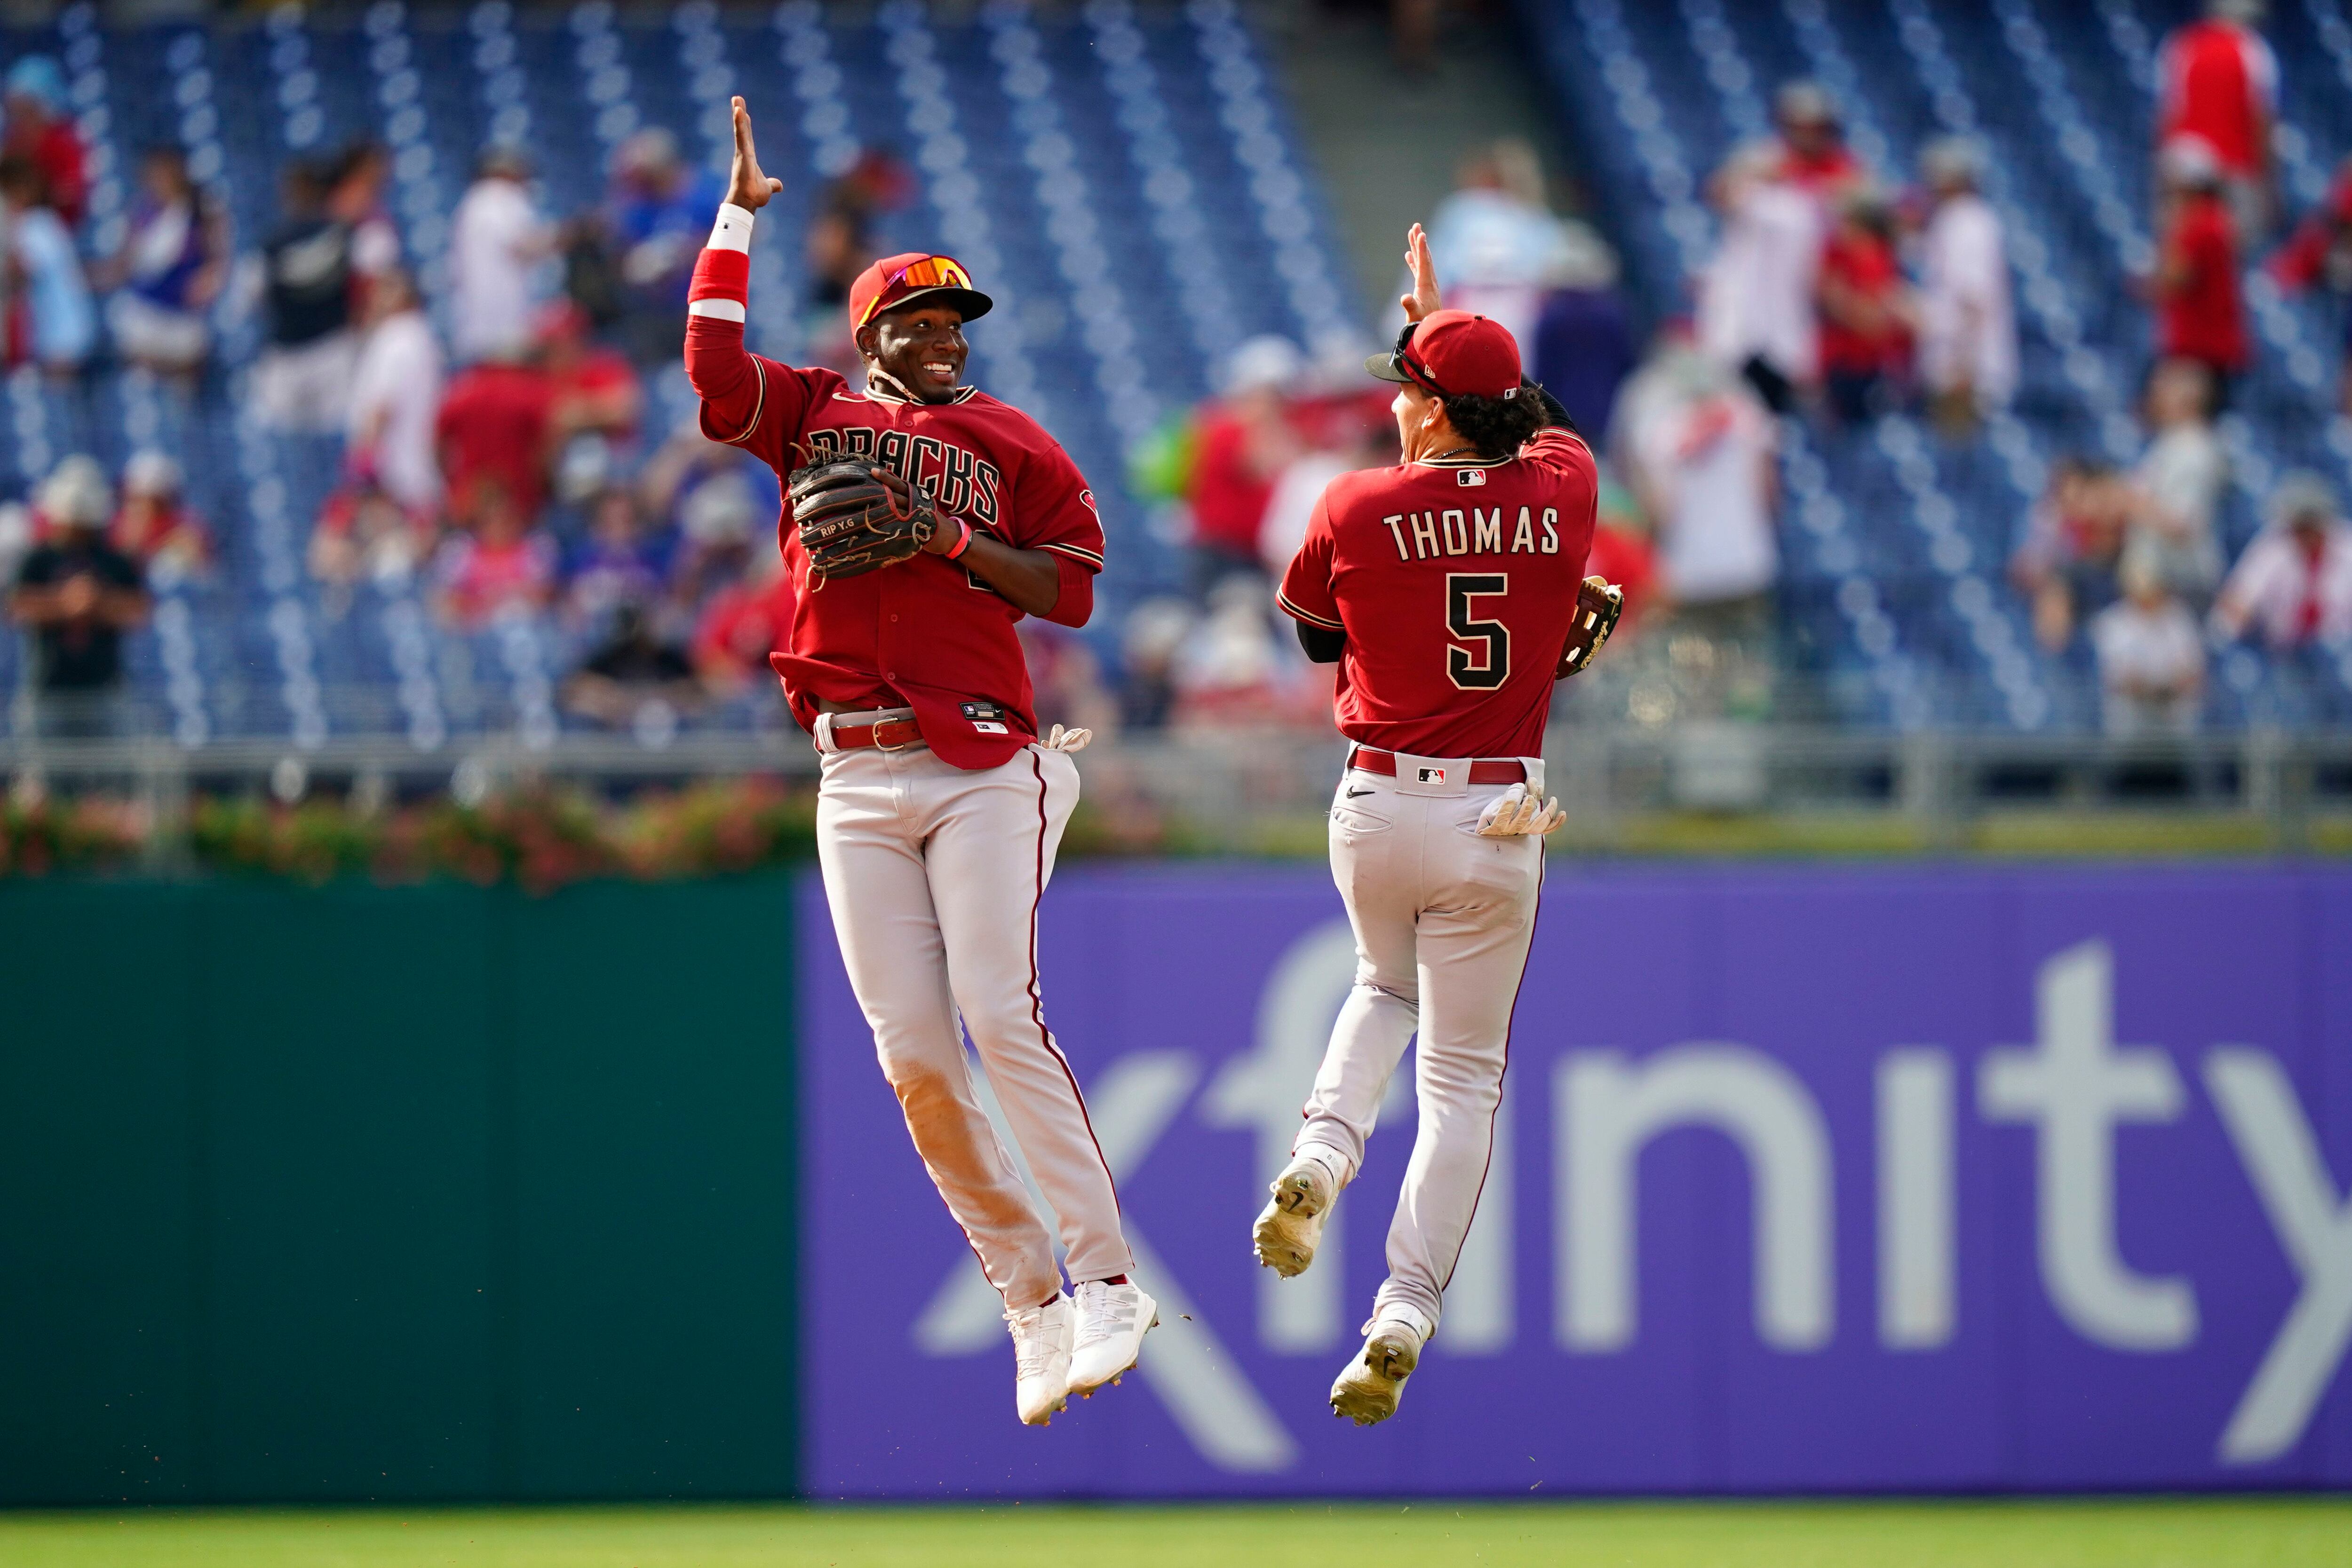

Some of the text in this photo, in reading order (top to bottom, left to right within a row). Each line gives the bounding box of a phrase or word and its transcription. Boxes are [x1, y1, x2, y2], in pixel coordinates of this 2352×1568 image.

[820, 525, 836, 537] RIP
[1383, 506, 1559, 561] THOMAS
[1446, 573, 1510, 690] 5
[1581, 620, 1608, 669] Rawlings
[915, 920, 2352, 1472] xfinity
